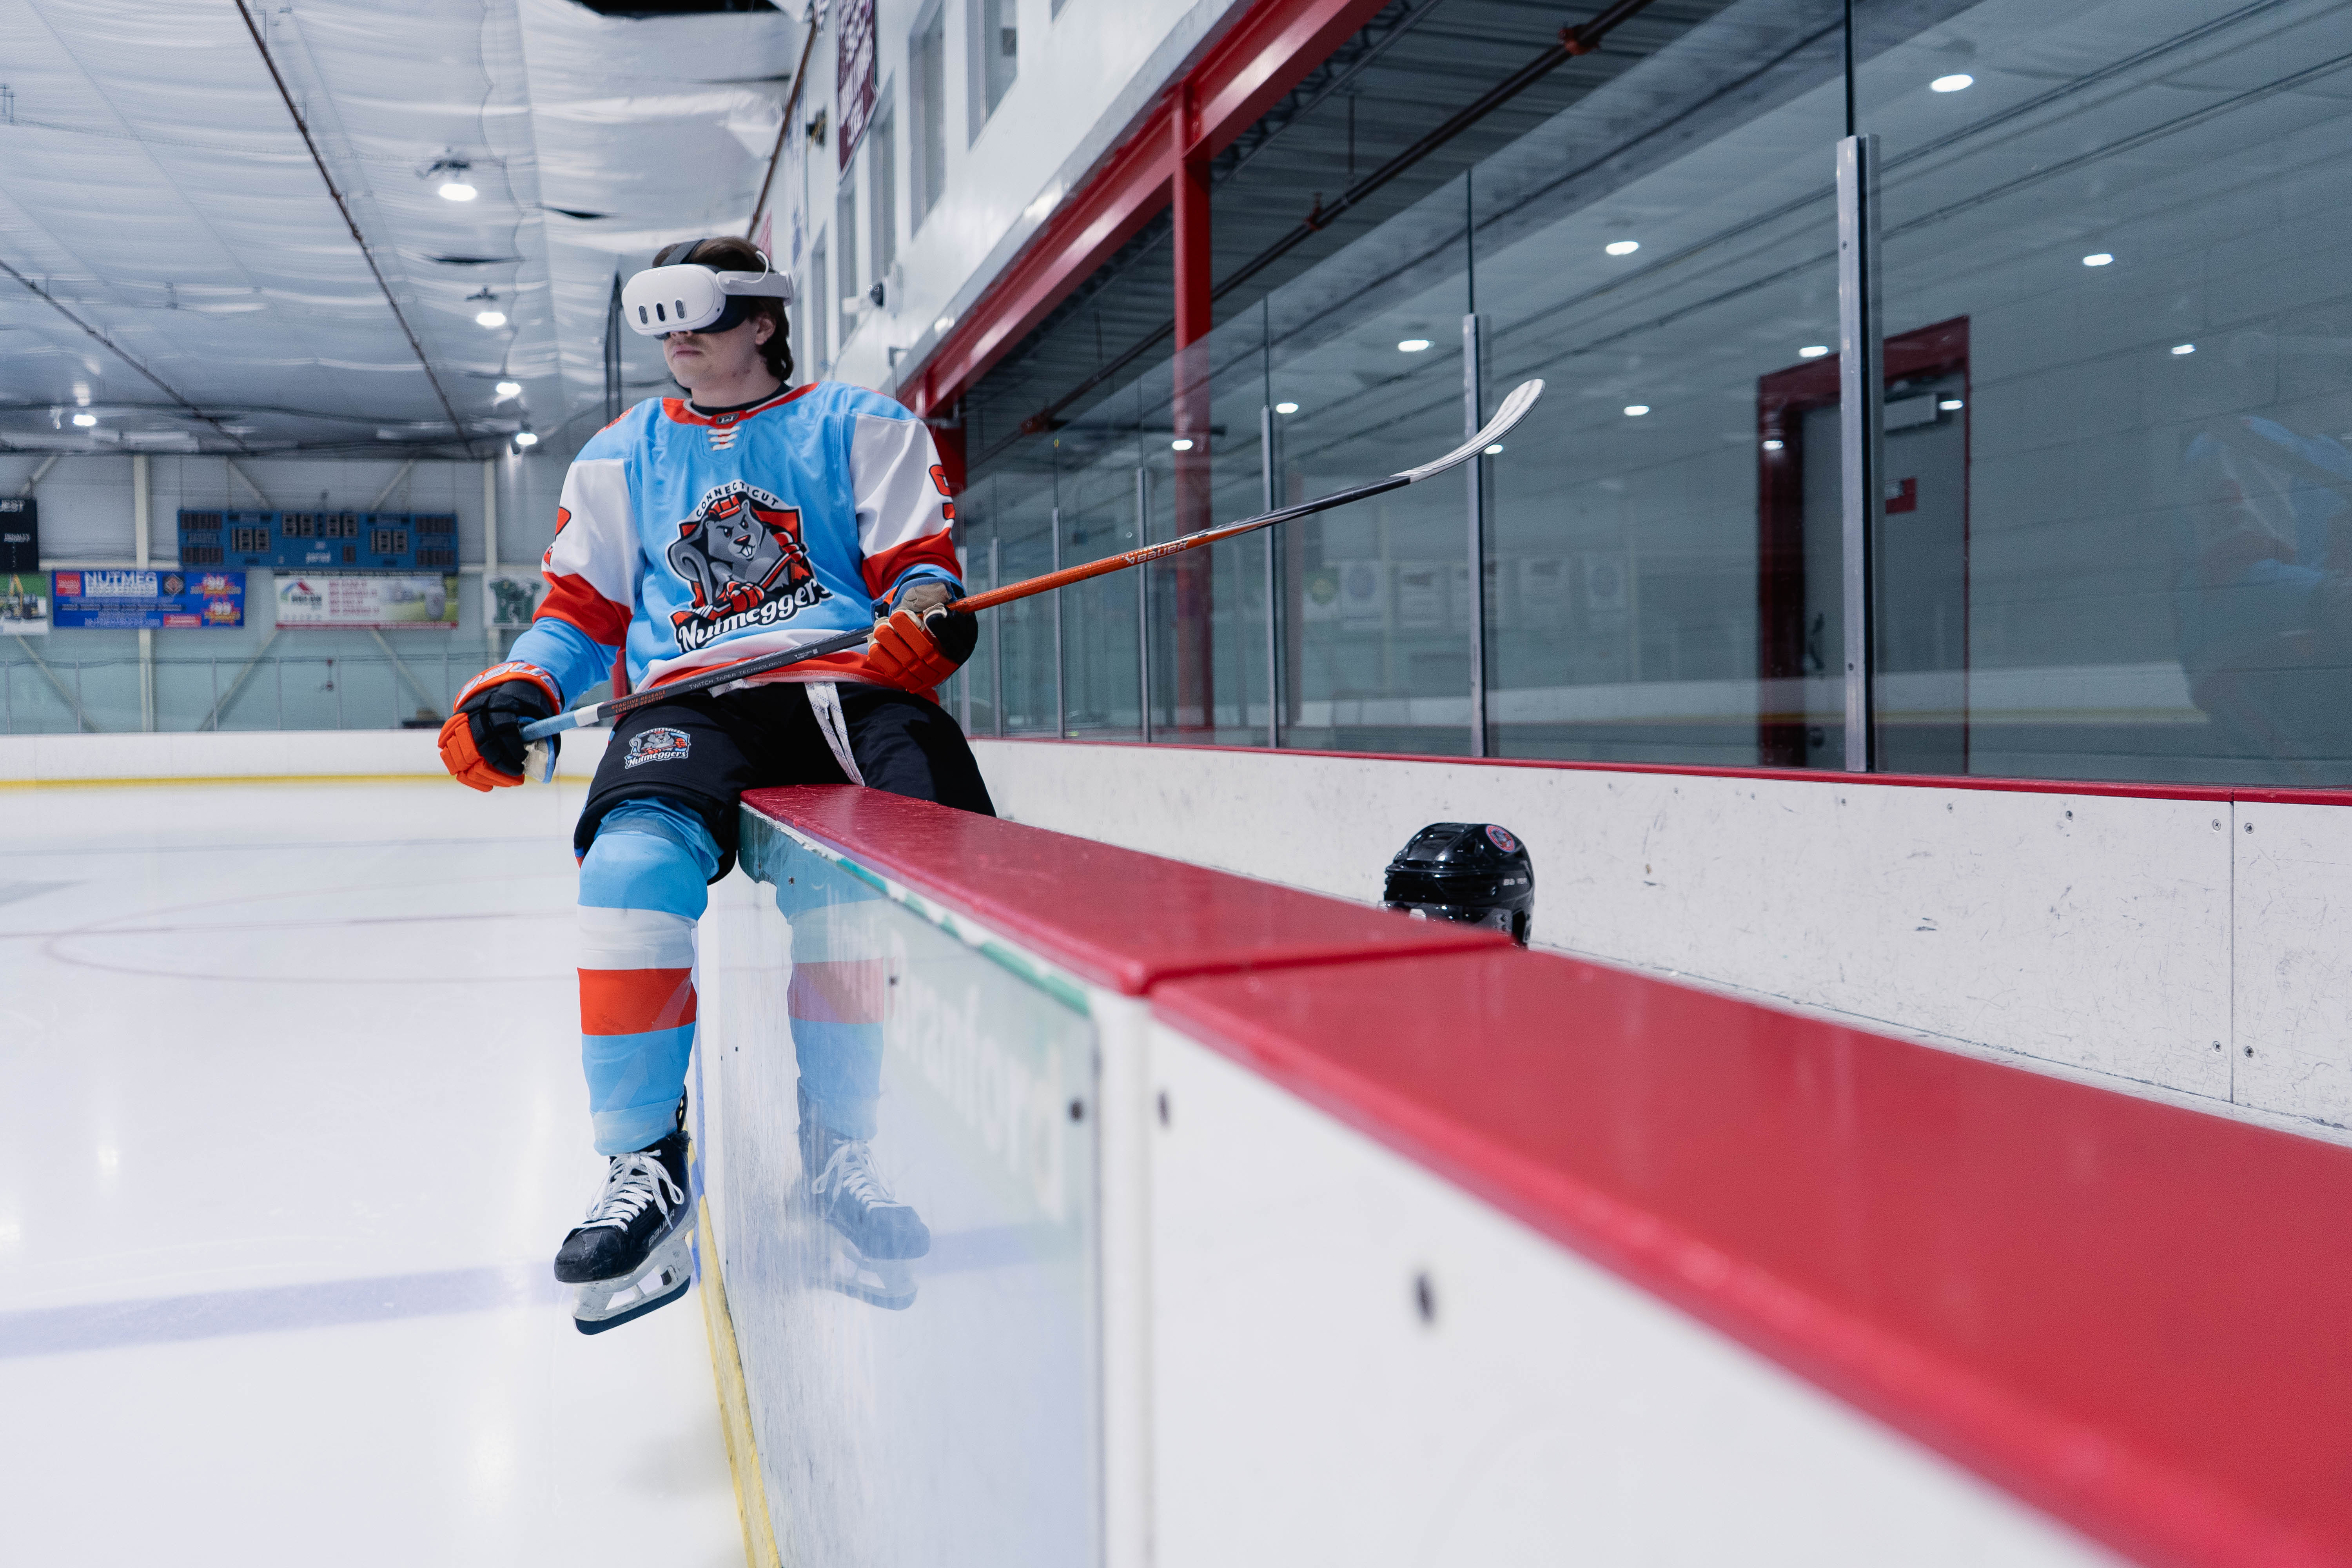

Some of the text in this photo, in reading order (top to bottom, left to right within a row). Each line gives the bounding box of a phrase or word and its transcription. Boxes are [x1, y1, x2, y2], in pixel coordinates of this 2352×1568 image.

[696, 481, 779, 517] CONNECTICUT
[85, 571, 157, 583] NUTMEG
[689, 660, 782, 690] TWITCH TAPER TECHNOLOGY
[611, 690, 666, 710] REACTIVE RELEASE
[615, 703, 639, 713] LANCER
[628, 751, 686, 768] Nutmeggers
